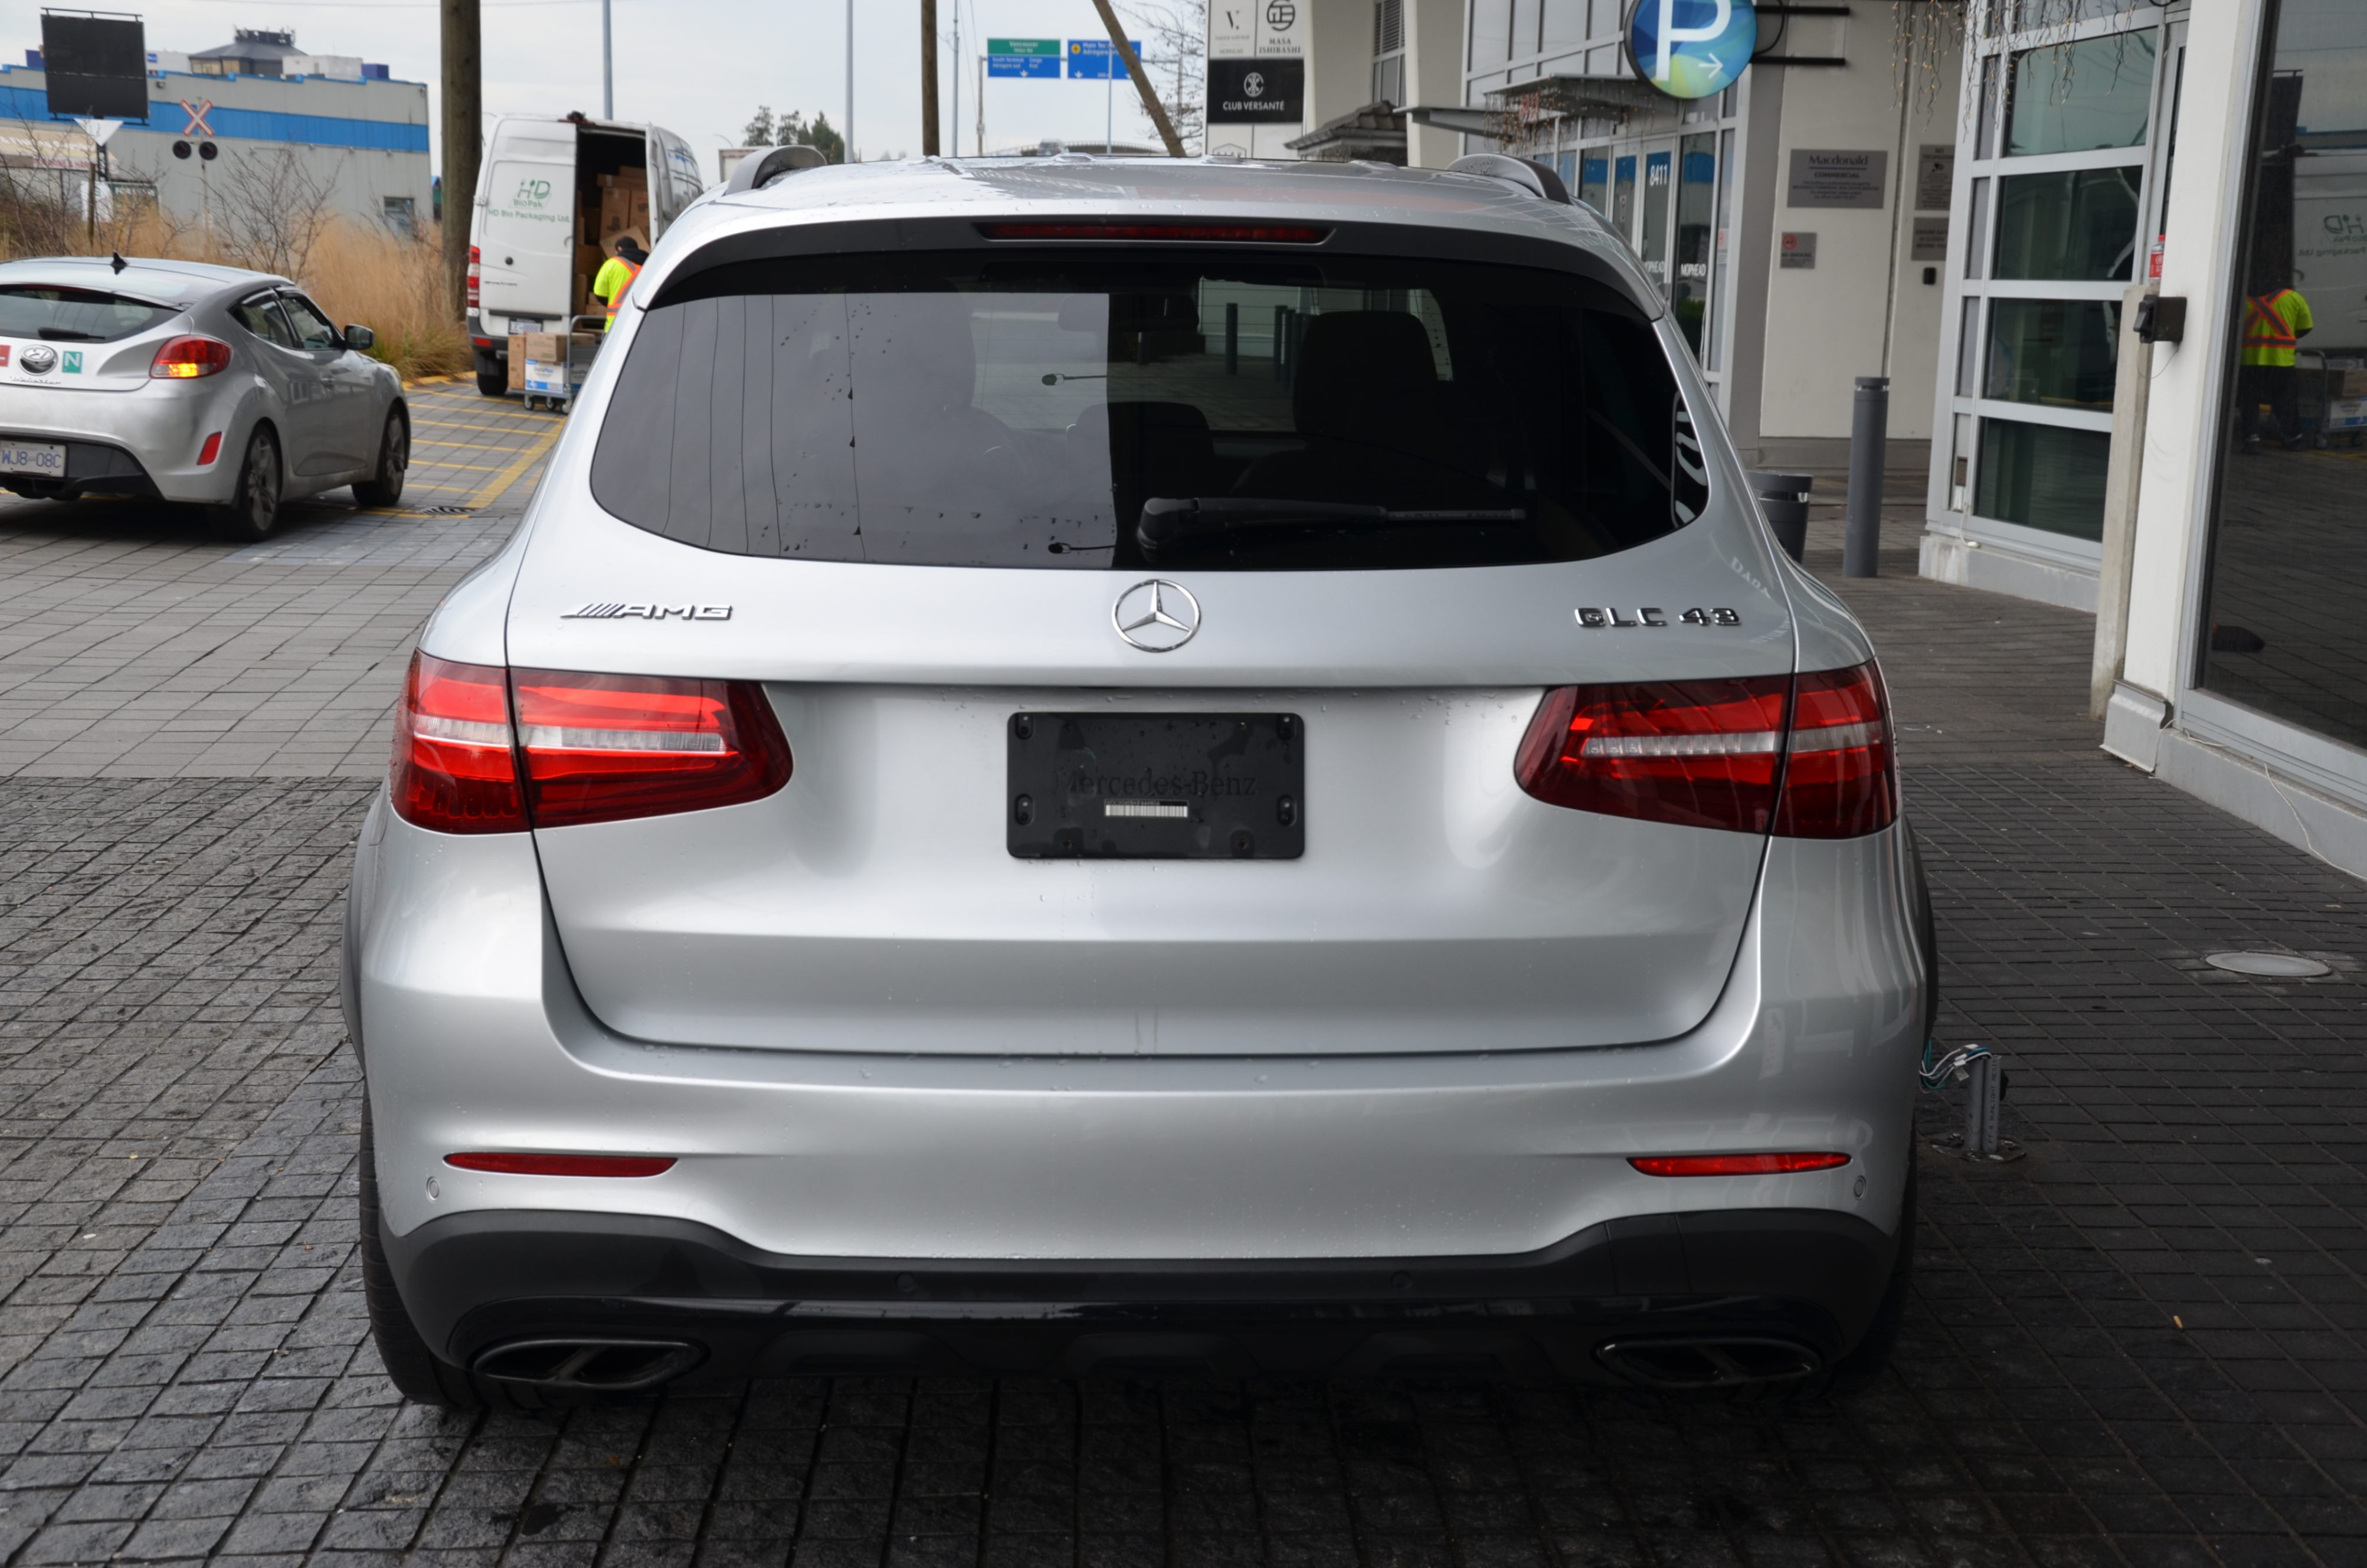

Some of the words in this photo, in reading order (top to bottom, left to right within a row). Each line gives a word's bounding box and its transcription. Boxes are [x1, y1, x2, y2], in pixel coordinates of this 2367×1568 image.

[1656, 0, 1732, 81] P
[1223, 101, 1242, 110] CLUB
[1243, 100, 1285, 110] VERSANTÉ
[1809, 155, 1868, 165] Macdonald
[1649, 164, 1668, 186] 8411
[518, 179, 551, 199] HD
[516, 211, 555, 222] Packaging
[557, 214, 571, 222] Ltd.
[1681, 263, 1707, 277] MOPHEAD
[64, 352, 81, 368] N
[612, 603, 733, 620] AMG
[1574, 607, 1668, 627] GLC
[1678, 607, 1741, 627] 43
[1054, 770, 1258, 797] Mercedes-Benz
